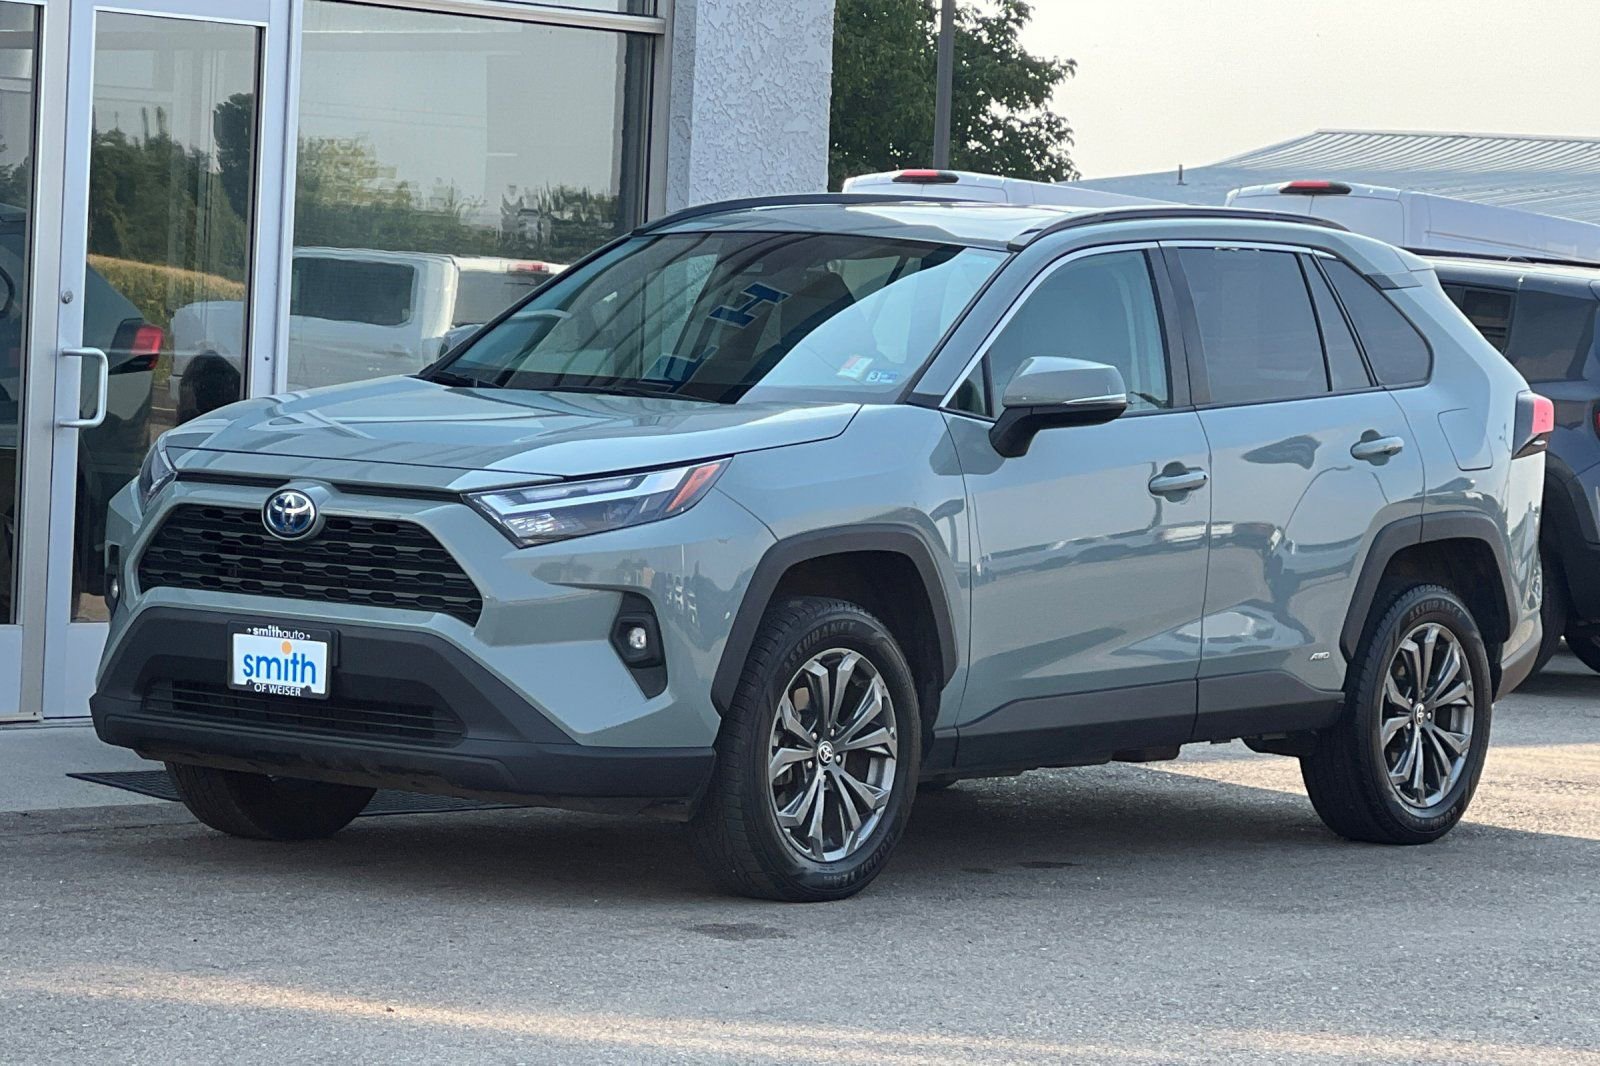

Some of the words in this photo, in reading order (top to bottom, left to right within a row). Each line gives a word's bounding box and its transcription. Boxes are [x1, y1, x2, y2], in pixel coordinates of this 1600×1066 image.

[252, 625, 305, 639] smithauto
[785, 621, 857, 672] ASSURANCE
[243, 643, 316, 684] smith
[253, 683, 266, 692] OF
[268, 685, 300, 696] WEISER
